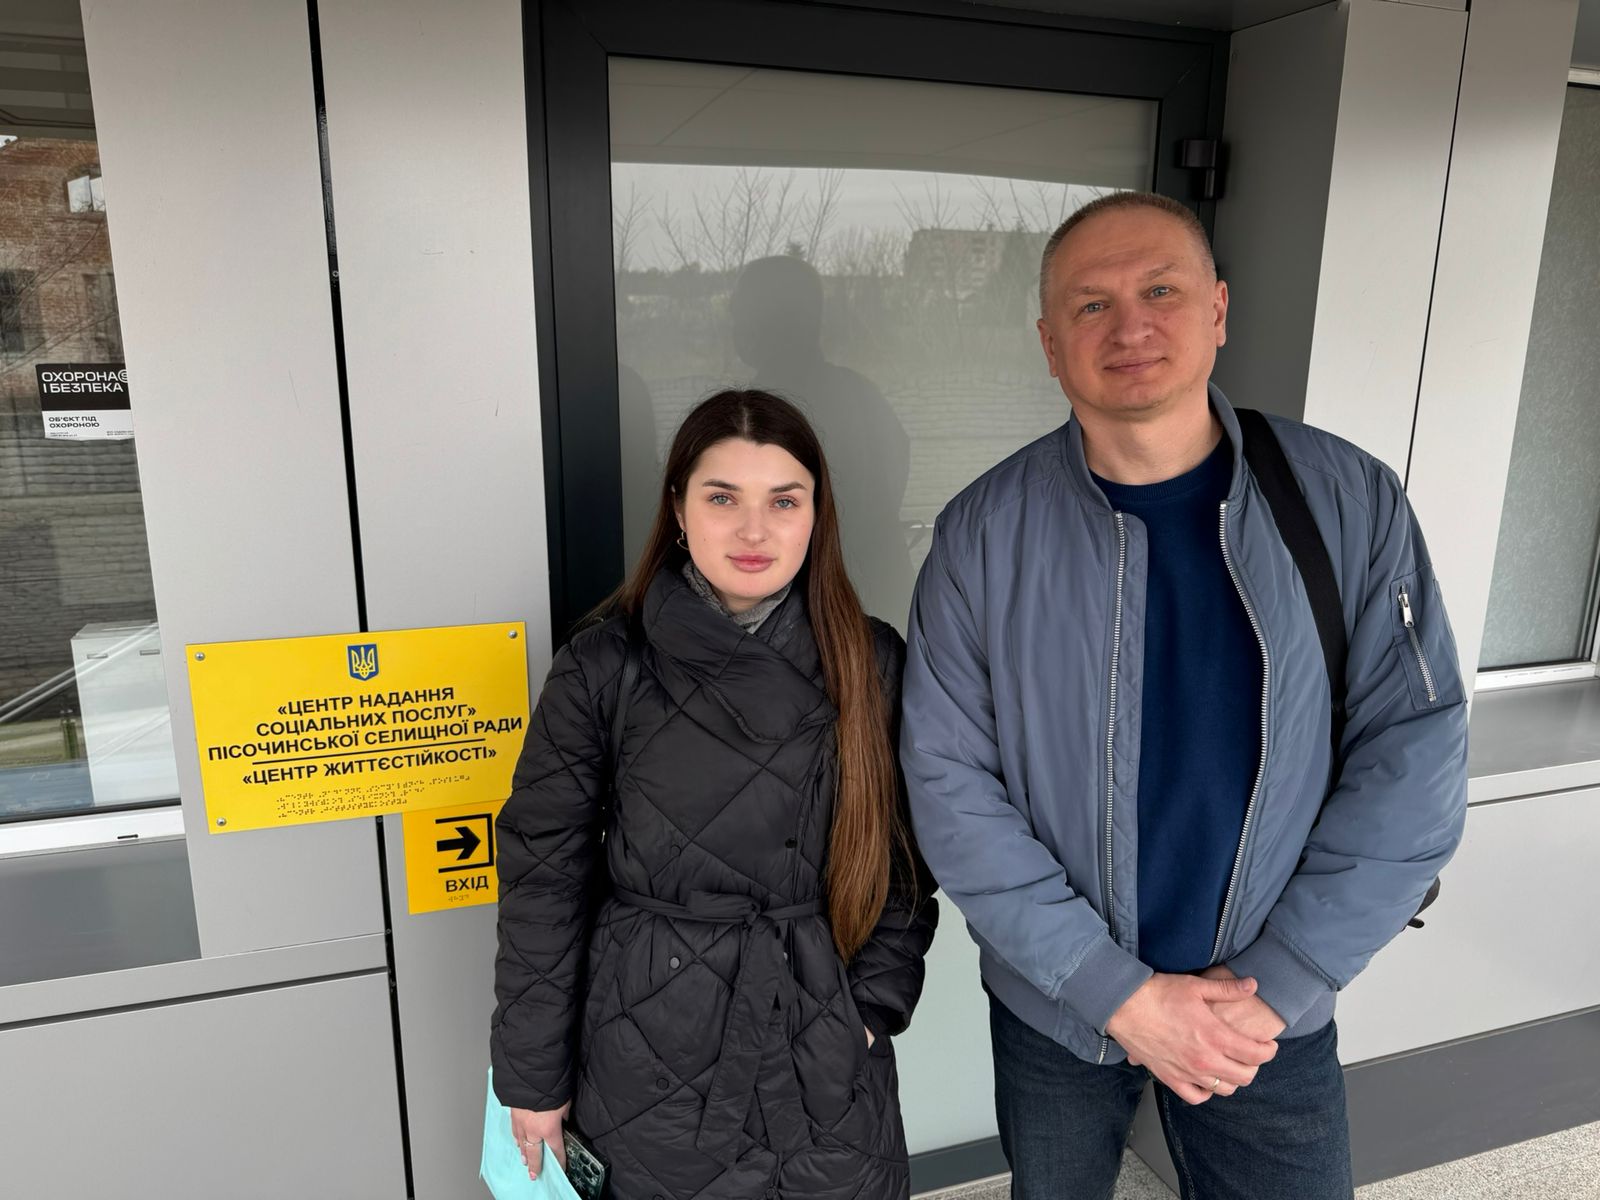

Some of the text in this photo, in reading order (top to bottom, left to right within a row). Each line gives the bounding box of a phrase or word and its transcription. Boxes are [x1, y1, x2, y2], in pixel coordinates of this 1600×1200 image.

[41, 371, 119, 382] ОХОРОНА
[43, 382, 124, 393] І БЕЗПЕКА
[278, 687, 454, 716] «ЦЕНТР НАДАННЯ
[256, 704, 476, 736] СОЦІАЛЬНИХ ПОСЛУГ»
[208, 717, 522, 761] ПІСОЧИНСЬКОЇ СЕЛИЩНОЇ РАДИ
[242, 746, 497, 785] «ЦЕНТР ЖИТТЄСТІЙКОСТІ»
[445, 875, 489, 892] ВХІД
